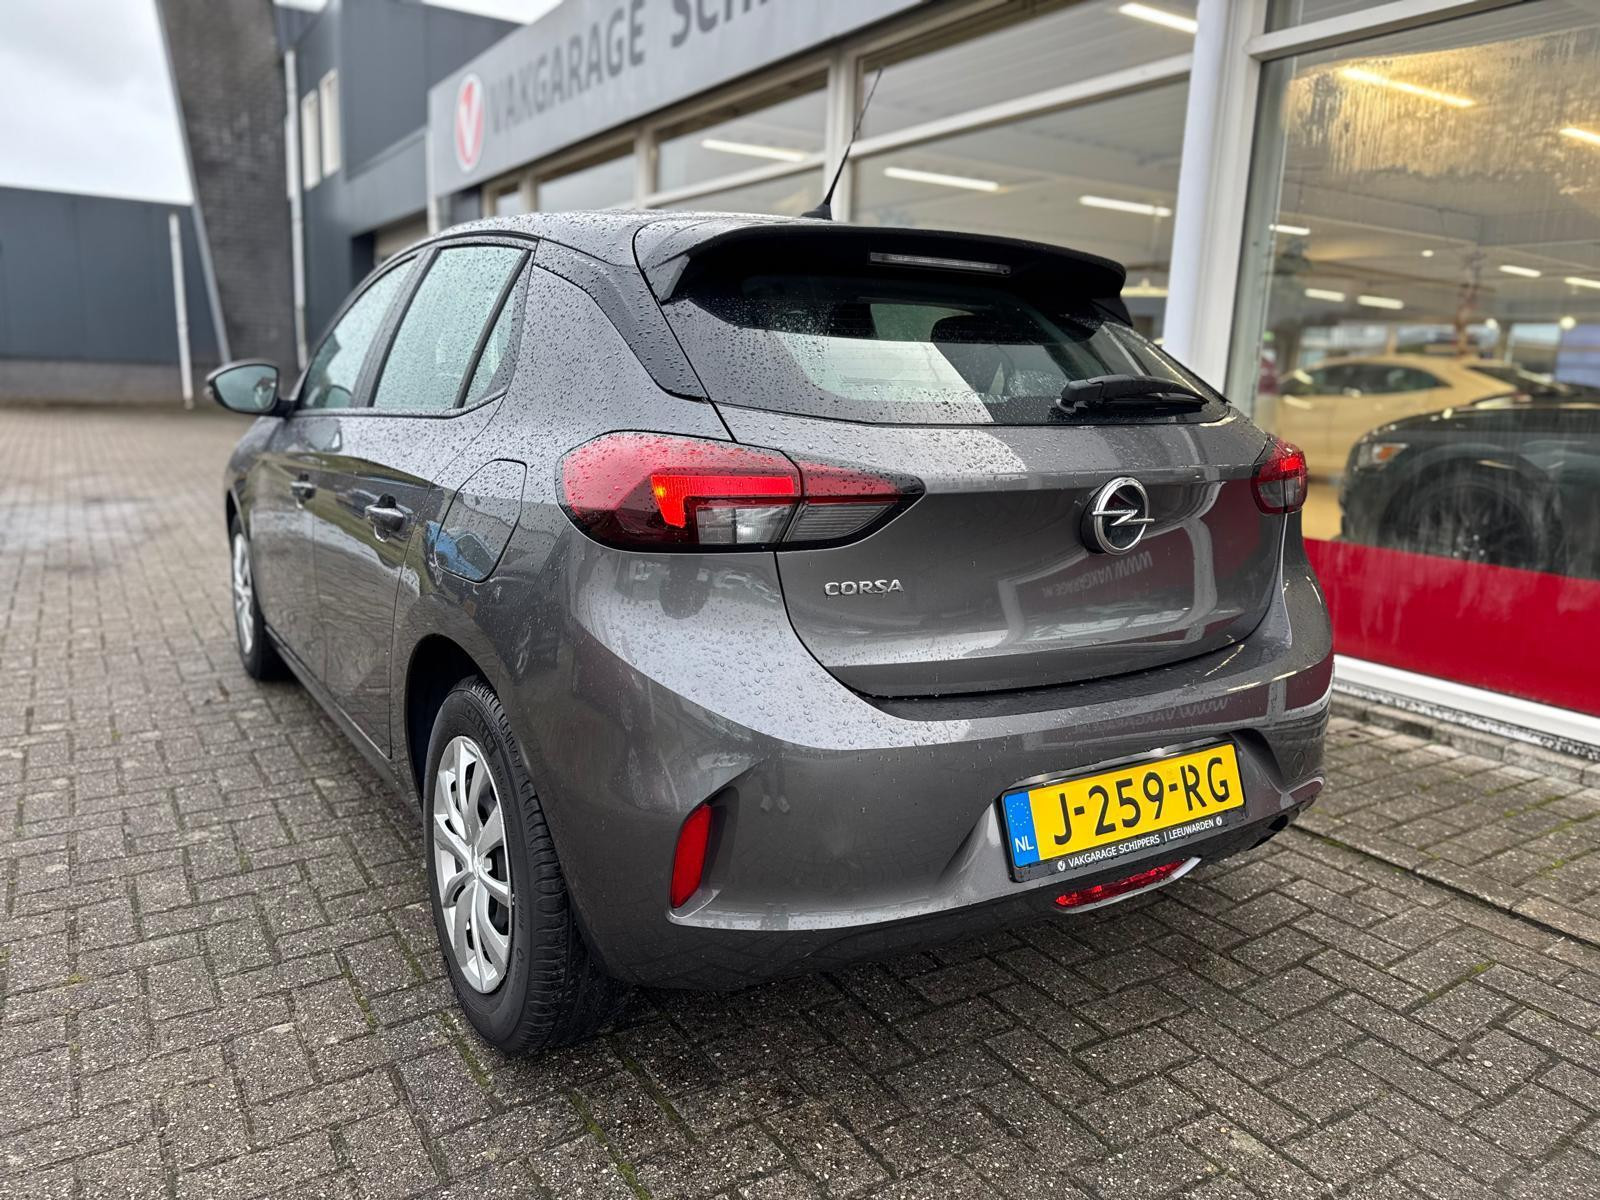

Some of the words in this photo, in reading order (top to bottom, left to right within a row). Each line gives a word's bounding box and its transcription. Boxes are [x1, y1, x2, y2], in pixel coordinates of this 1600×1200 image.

[489, 1, 645, 133] VAKGARAGE
[824, 579, 904, 596] CORSA
[1053, 757, 1231, 846] J-259-RG
[1014, 834, 1034, 853] NL
[1067, 848, 1118, 867] VAKGARAGE
[1118, 834, 1160, 855] SCHIPPERS
[1169, 820, 1214, 840] LEEUWARDEN
